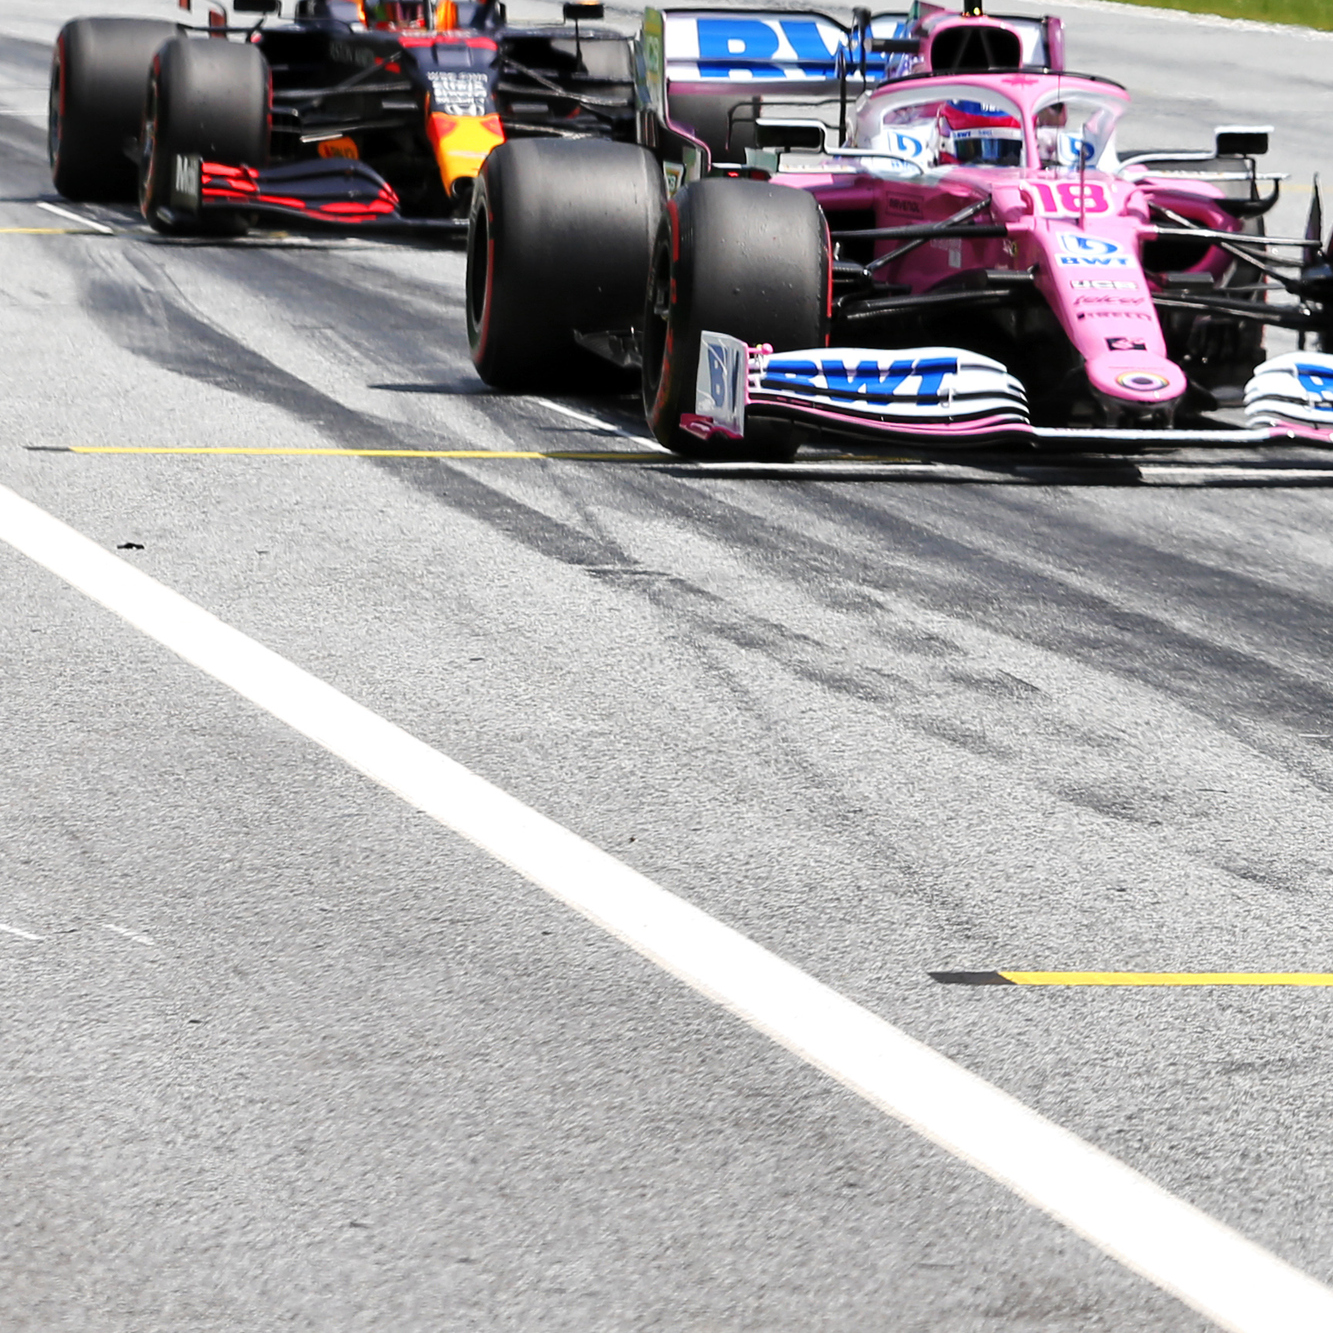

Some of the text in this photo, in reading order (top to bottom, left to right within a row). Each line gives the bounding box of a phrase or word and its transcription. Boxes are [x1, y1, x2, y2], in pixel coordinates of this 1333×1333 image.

[1032, 183, 1109, 213] 18
[1061, 256, 1128, 265] BWT
[761, 357, 957, 406] BWT
